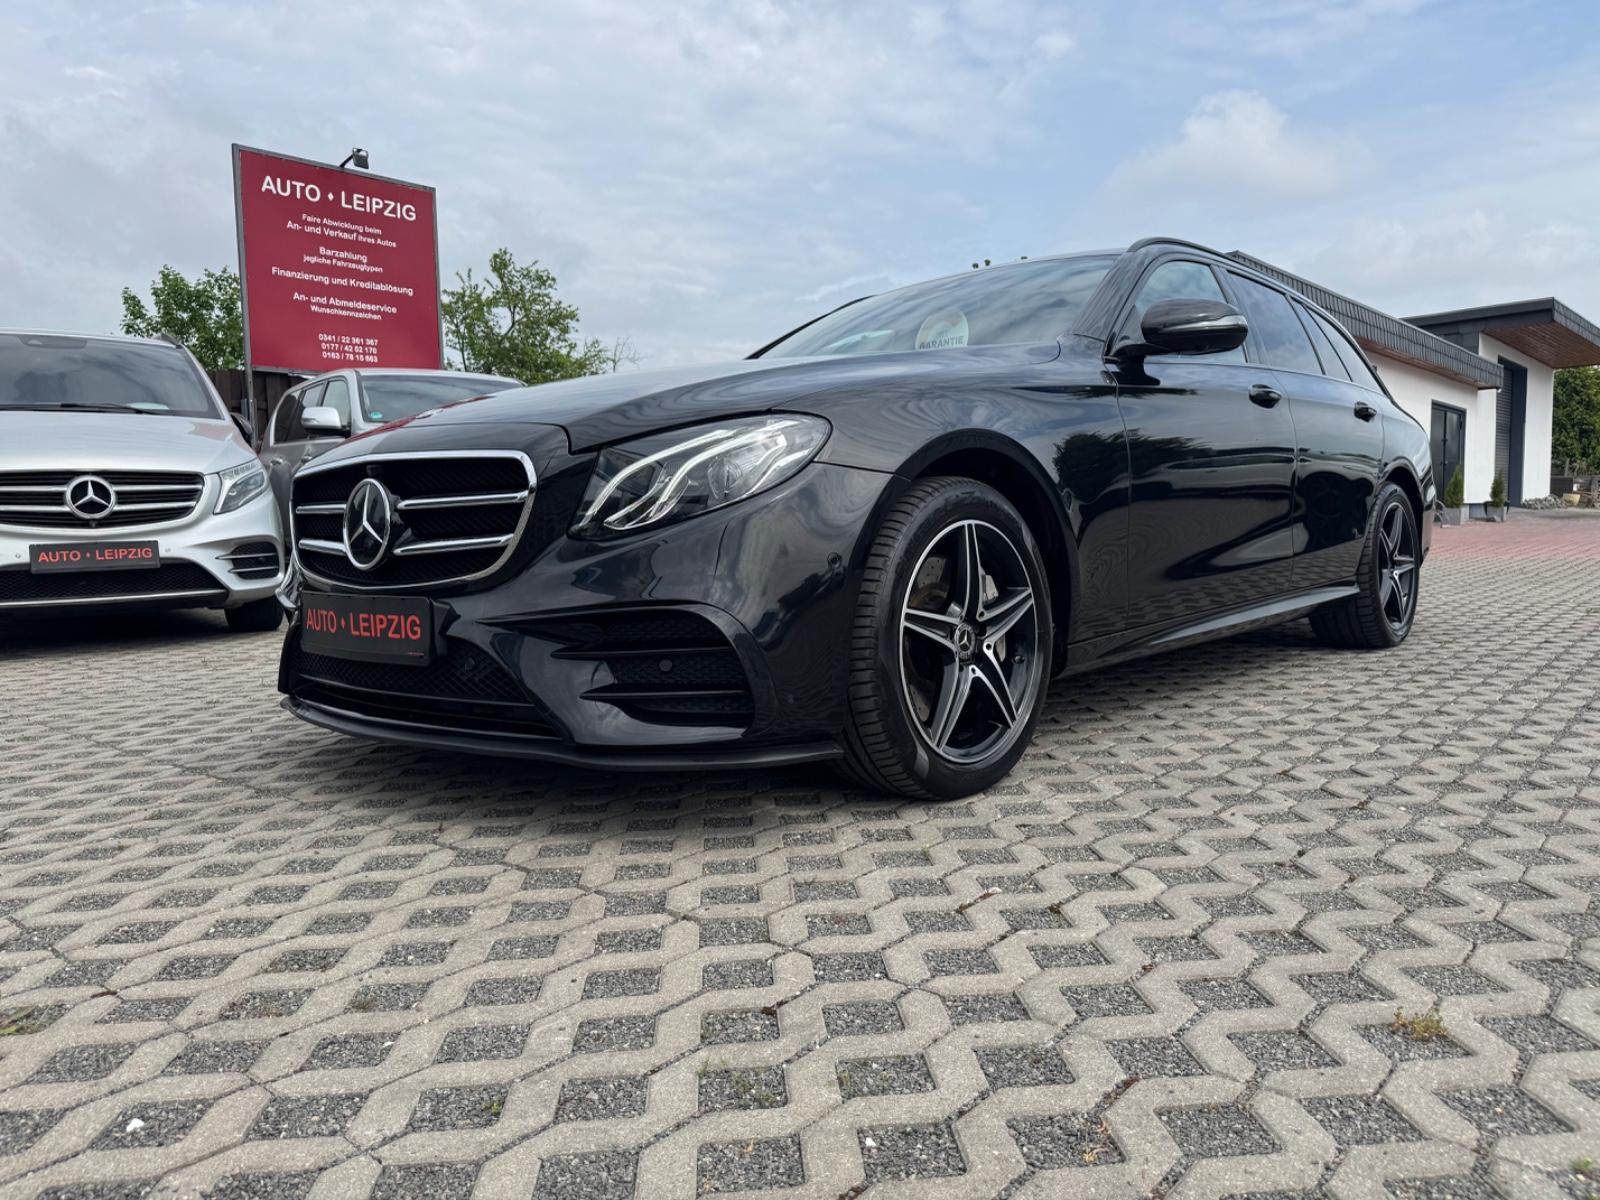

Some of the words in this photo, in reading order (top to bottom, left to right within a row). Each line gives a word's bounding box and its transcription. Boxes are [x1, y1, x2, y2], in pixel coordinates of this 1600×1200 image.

[261, 175, 321, 202] AUTO
[341, 191, 417, 221] LEIPZIG
[286, 220, 303, 230] An-
[304, 224, 321, 234] und
[323, 227, 357, 241] Verkauf
[376, 238, 397, 248] Autos
[302, 213, 321, 224] Faire
[322, 217, 364, 233] Abwicklung
[364, 224, 382, 235] beim
[303, 254, 331, 265] jegliche
[332, 258, 383, 273] Fahrzeugtypen
[319, 246, 368, 263] Barzahlung
[271, 266, 330, 285] Finanzierung
[331, 277, 348, 286] und
[349, 278, 414, 296] Kreditablösung
[293, 291, 309, 301] An-
[310, 295, 327, 304] und
[329, 296, 397, 314] Abmeldeservice
[310, 305, 382, 321] Wunschkennzeichen
[318, 333, 336, 342] 0341
[321, 343, 339, 352] 0177
[38, 549, 81, 563] AUTO
[95, 547, 153, 561] LEIPZIG
[306, 607, 337, 634] AUTO
[350, 612, 422, 640] LEIPZIG
